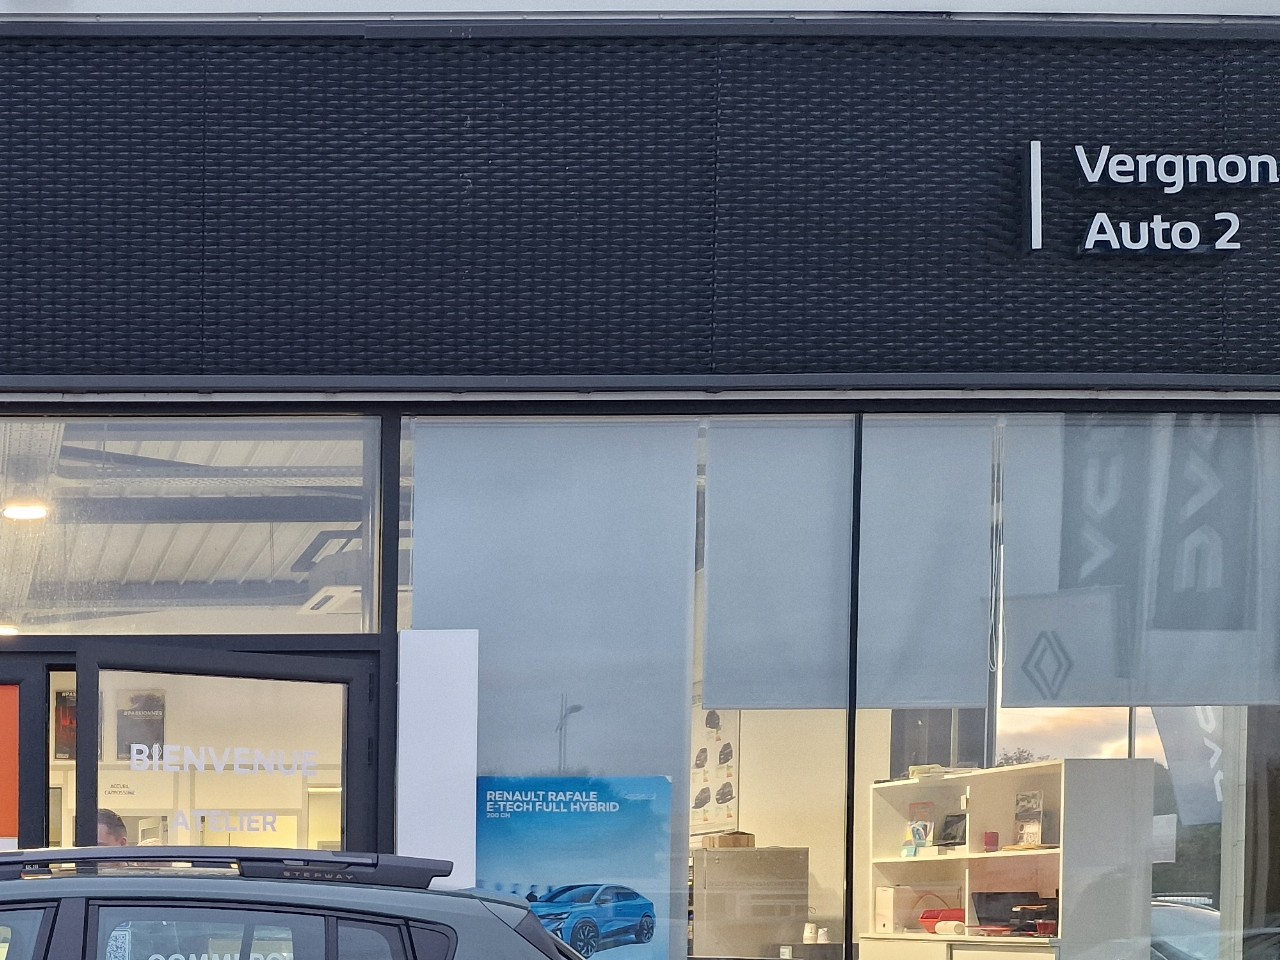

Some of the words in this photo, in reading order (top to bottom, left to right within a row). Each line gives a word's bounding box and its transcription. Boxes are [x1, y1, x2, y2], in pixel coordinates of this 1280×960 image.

[1074, 144, 1280, 194] Vergnon
[1084, 212, 1201, 250] Auto
[1214, 212, 1242, 250] 2
[130, 742, 319, 777] BIENVENUE
[486, 790, 545, 801] RENAULT
[547, 791, 598, 802] RAFALE
[486, 801, 533, 812] E-TECH
[535, 802, 568, 812] FULL
[570, 802, 620, 813] HYBRID
[172, 810, 278, 833] ATELIER
[282, 870, 356, 881] STEPWAY
